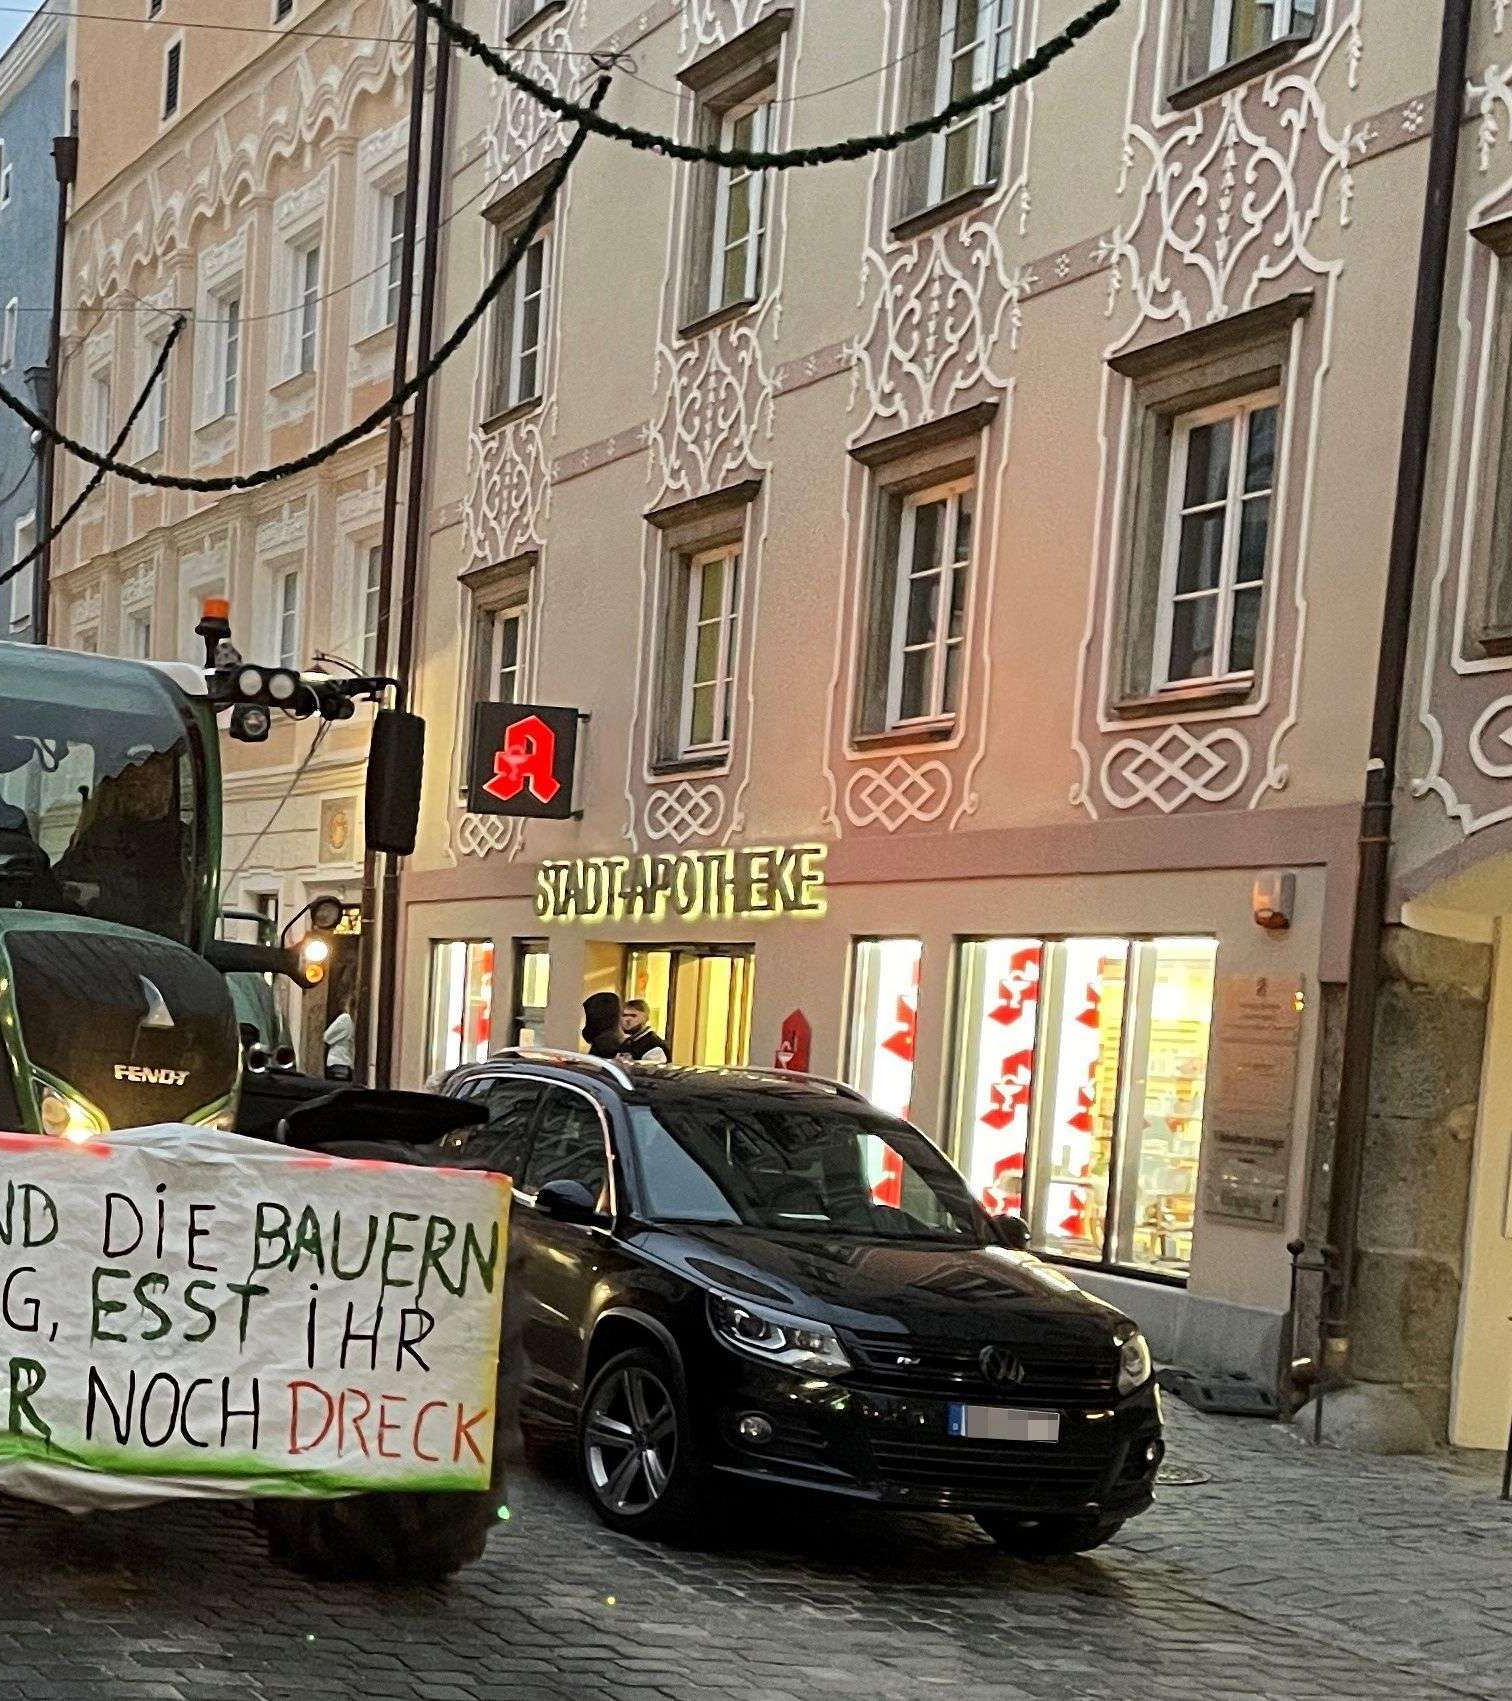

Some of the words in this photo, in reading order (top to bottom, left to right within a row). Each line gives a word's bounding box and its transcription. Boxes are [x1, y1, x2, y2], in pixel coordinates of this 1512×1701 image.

[534, 847, 825, 918] STADT-APOTHEKE
[114, 1064, 190, 1086] FENDT
[254, 1201, 499, 1298] BAUERN
[91, 1267, 269, 1353] ESST
[86, 1365, 260, 1450] NOCH
[287, 1380, 488, 1465] DRECK
